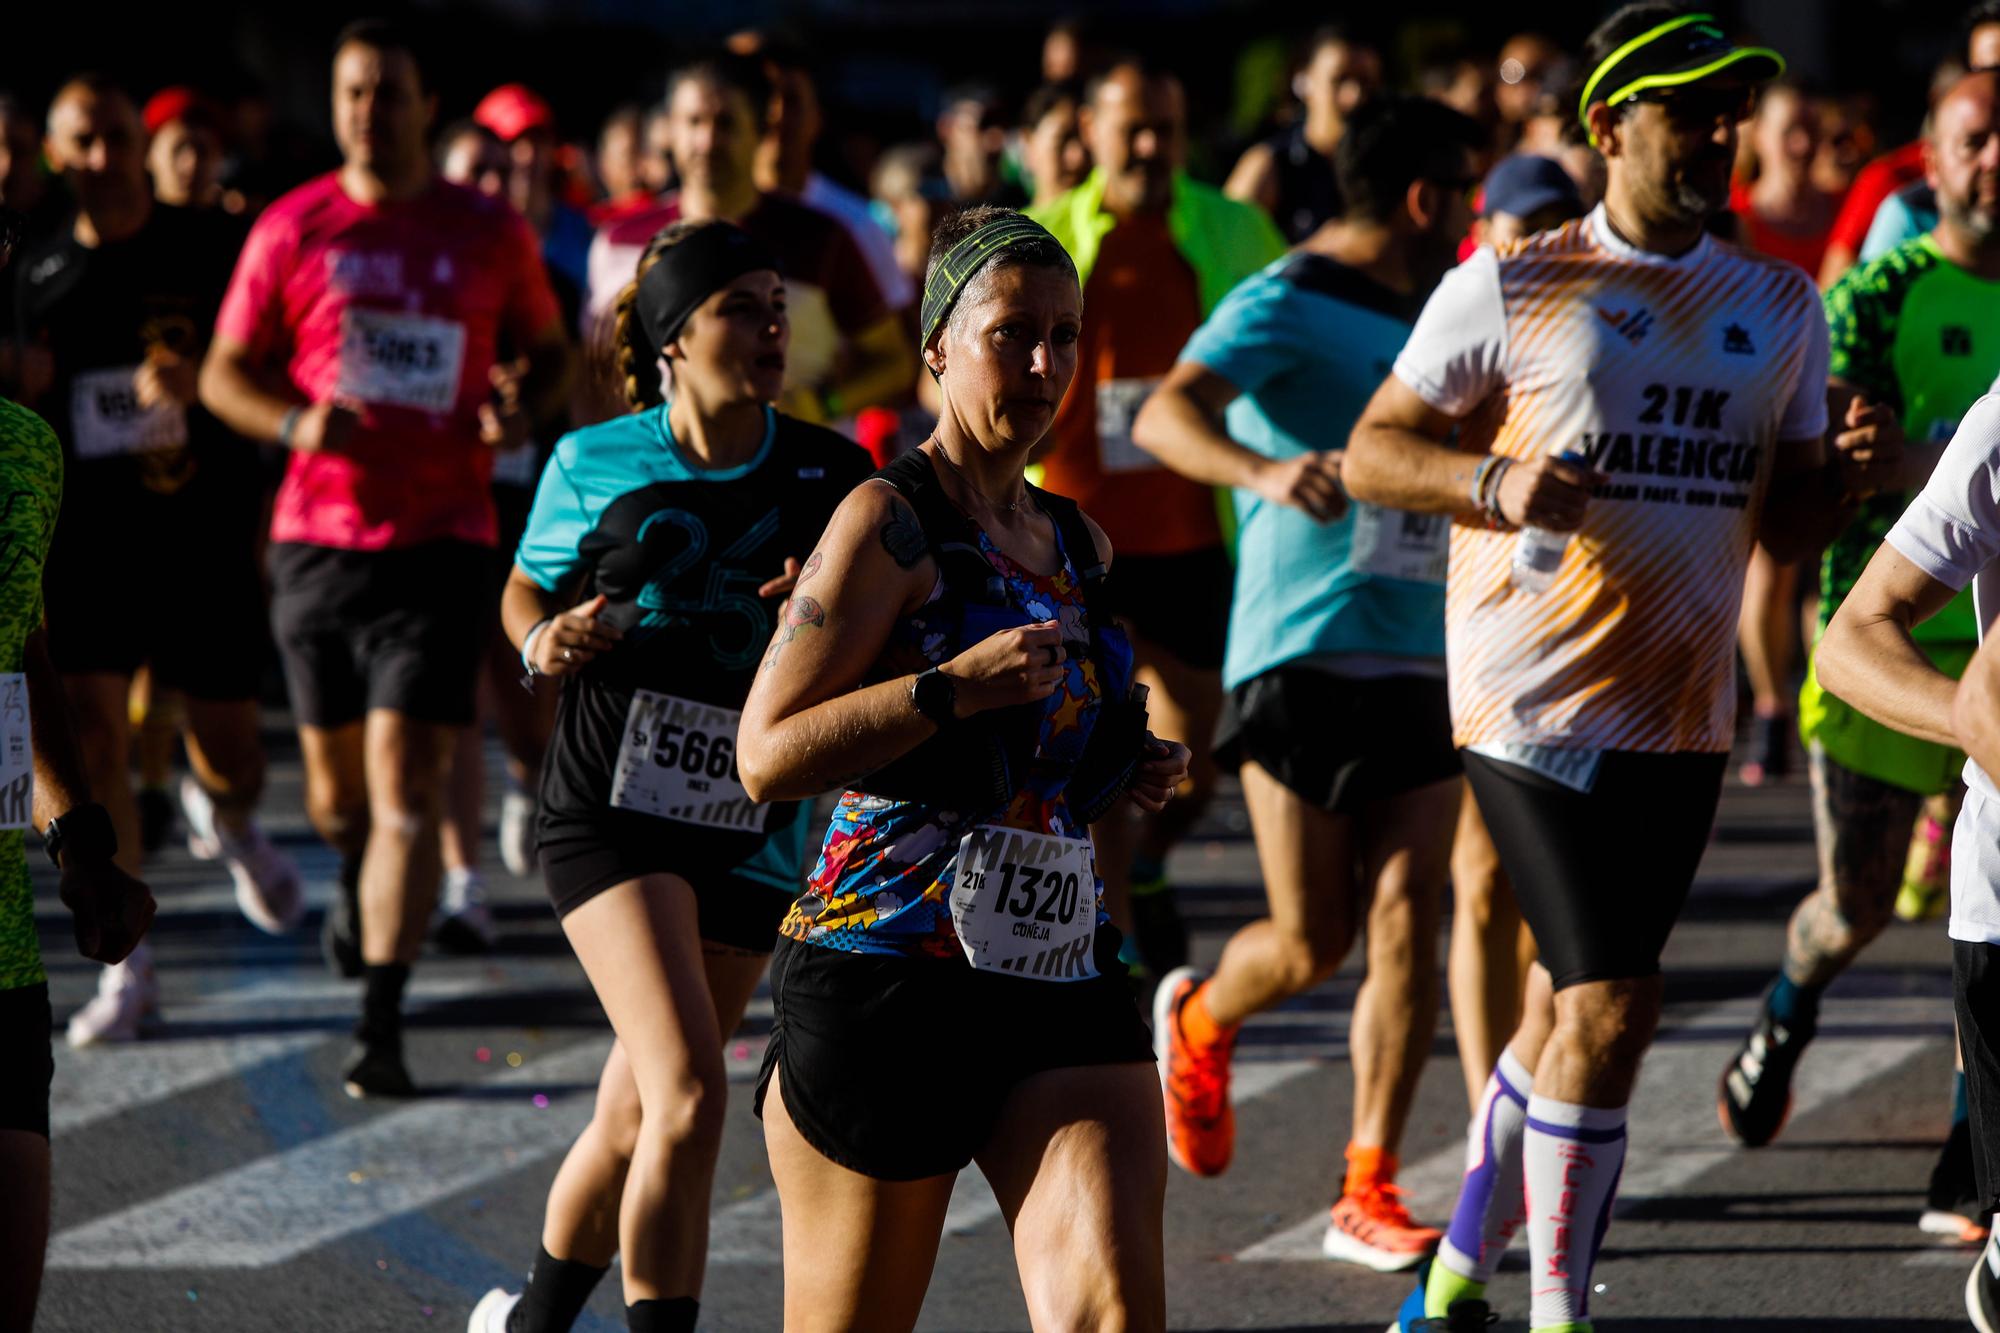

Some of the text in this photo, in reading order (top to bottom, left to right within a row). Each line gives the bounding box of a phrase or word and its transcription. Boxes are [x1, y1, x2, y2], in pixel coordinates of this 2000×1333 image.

[1639, 383, 1730, 428] 21K
[1585, 432, 1759, 482] VALENCIA
[654, 723, 741, 783] 566
[994, 862, 1079, 925] 1320
